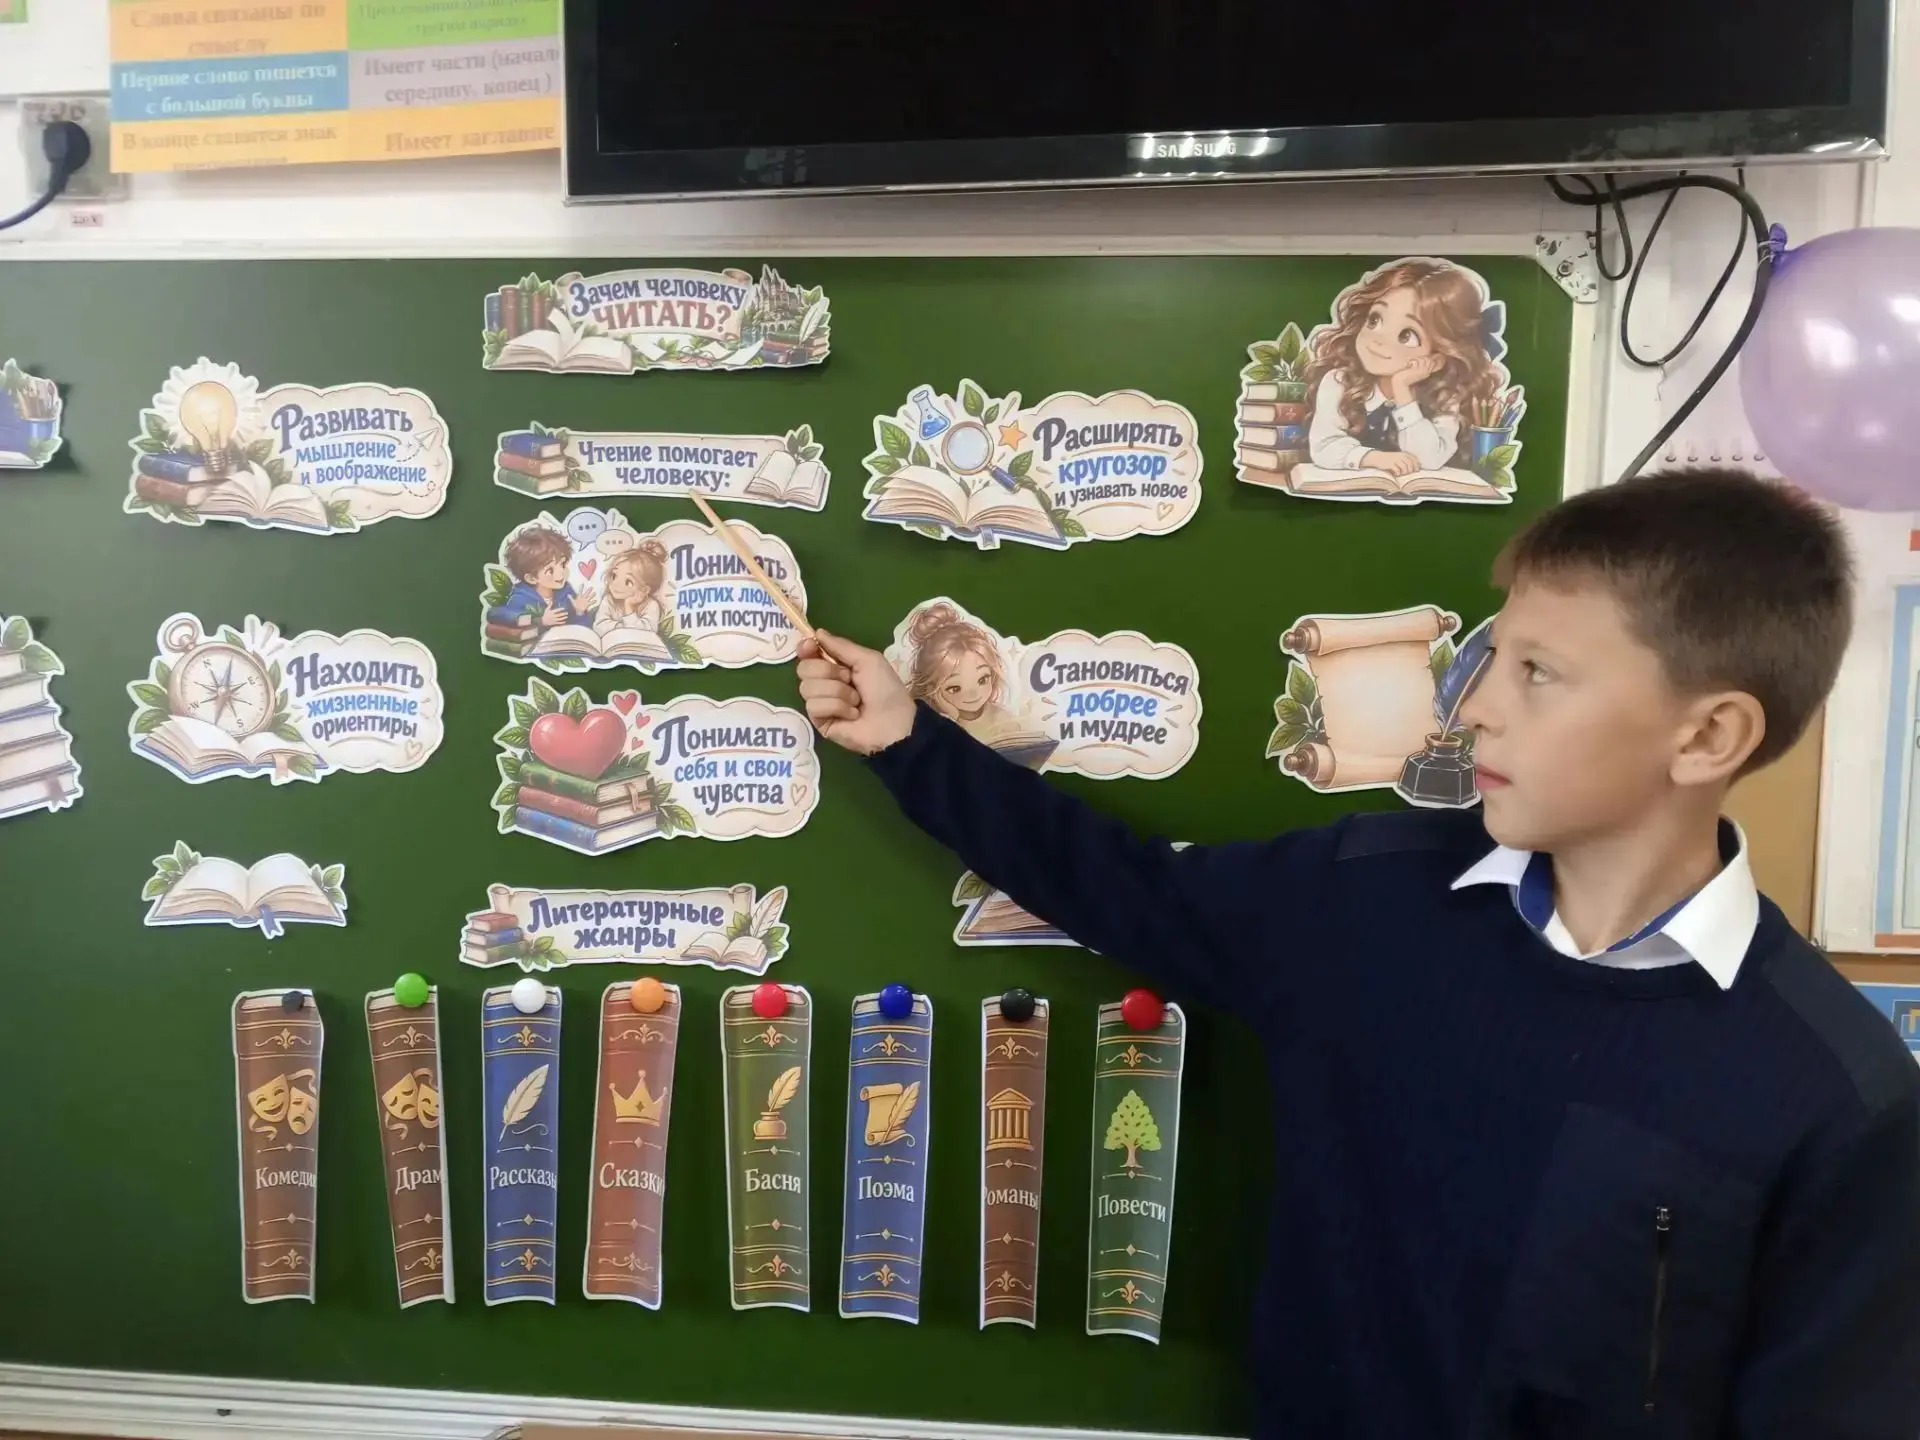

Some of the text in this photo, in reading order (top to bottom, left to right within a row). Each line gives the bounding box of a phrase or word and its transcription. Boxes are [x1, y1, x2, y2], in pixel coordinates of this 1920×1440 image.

[1157, 143, 1237, 158] SASUG
[569, 277, 747, 318] Зачем человеку
[593, 300, 733, 334] ЧИТАТЬ?
[271, 403, 414, 453] Развивать
[1033, 417, 1184, 462] Расширять
[294, 440, 397, 468] мышление
[578, 441, 759, 469] Чтение помогает
[301, 459, 427, 486] и воображение
[615, 466, 731, 492] человеку:
[1058, 454, 1168, 486] кругозор
[1055, 483, 1189, 507] и узнавать новое
[676, 586, 790, 610] других люд
[680, 610, 796, 634] и их поступк
[286, 652, 425, 698] Находить
[1029, 653, 1190, 696] Становиться
[306, 694, 419, 718] жизненные
[1066, 689, 1158, 718] добрее
[312, 715, 418, 741] ориентиры
[651, 715, 798, 766] Понимать
[1059, 719, 1168, 745] и мудрее
[674, 757, 793, 783] себя и свои
[693, 783, 785, 816] чувства
[527, 897, 725, 933] Литературные
[573, 926, 677, 953] жанры
[599, 1162, 665, 1197] Сказки
[745, 1168, 802, 1194] Басня
[858, 1175, 916, 1203] Поэма
[1097, 1194, 1167, 1223] Повести
